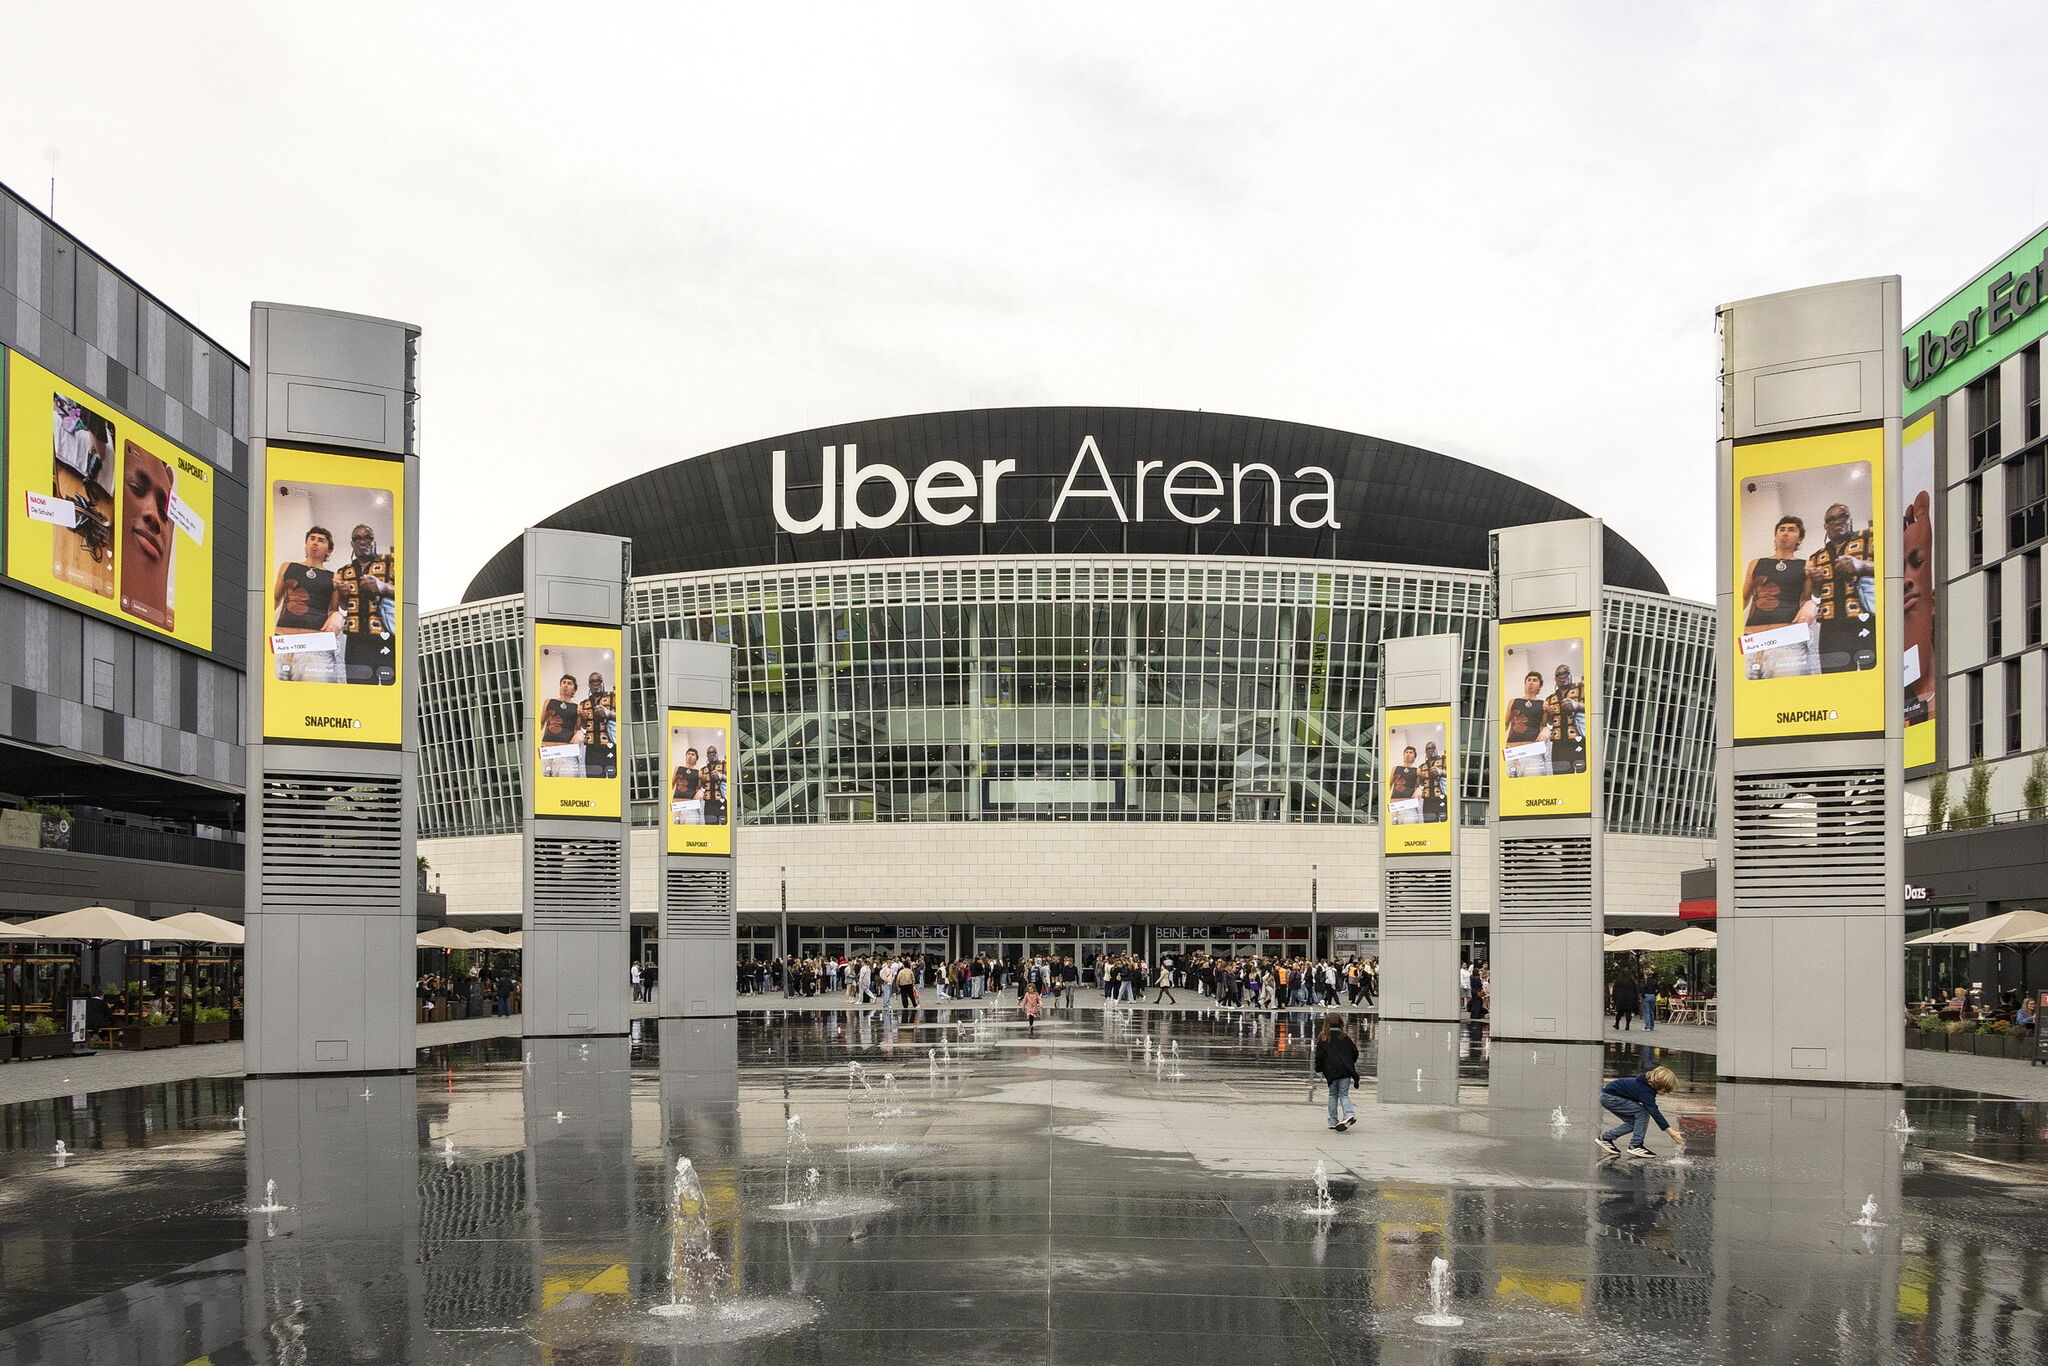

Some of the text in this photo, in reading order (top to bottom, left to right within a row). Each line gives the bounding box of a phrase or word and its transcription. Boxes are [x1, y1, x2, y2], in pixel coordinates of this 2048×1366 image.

[1902, 304, 1983, 391] Uber
[178, 456, 204, 481] SNAPCHAT
[772, 435, 1342, 535] Uber Arena
[1746, 643, 1760, 651] Aura
[1776, 709, 1829, 724] SNAPCHAT
[304, 716, 353, 729] SNAPCHAT
[560, 799, 590, 808] SNAPCHAT
[1525, 798, 1558, 807] SNAPCHAT
[854, 925, 880, 934] Eingang
[1038, 925, 1066, 934] Eingang
[1226, 926, 1253, 934] Eingang
